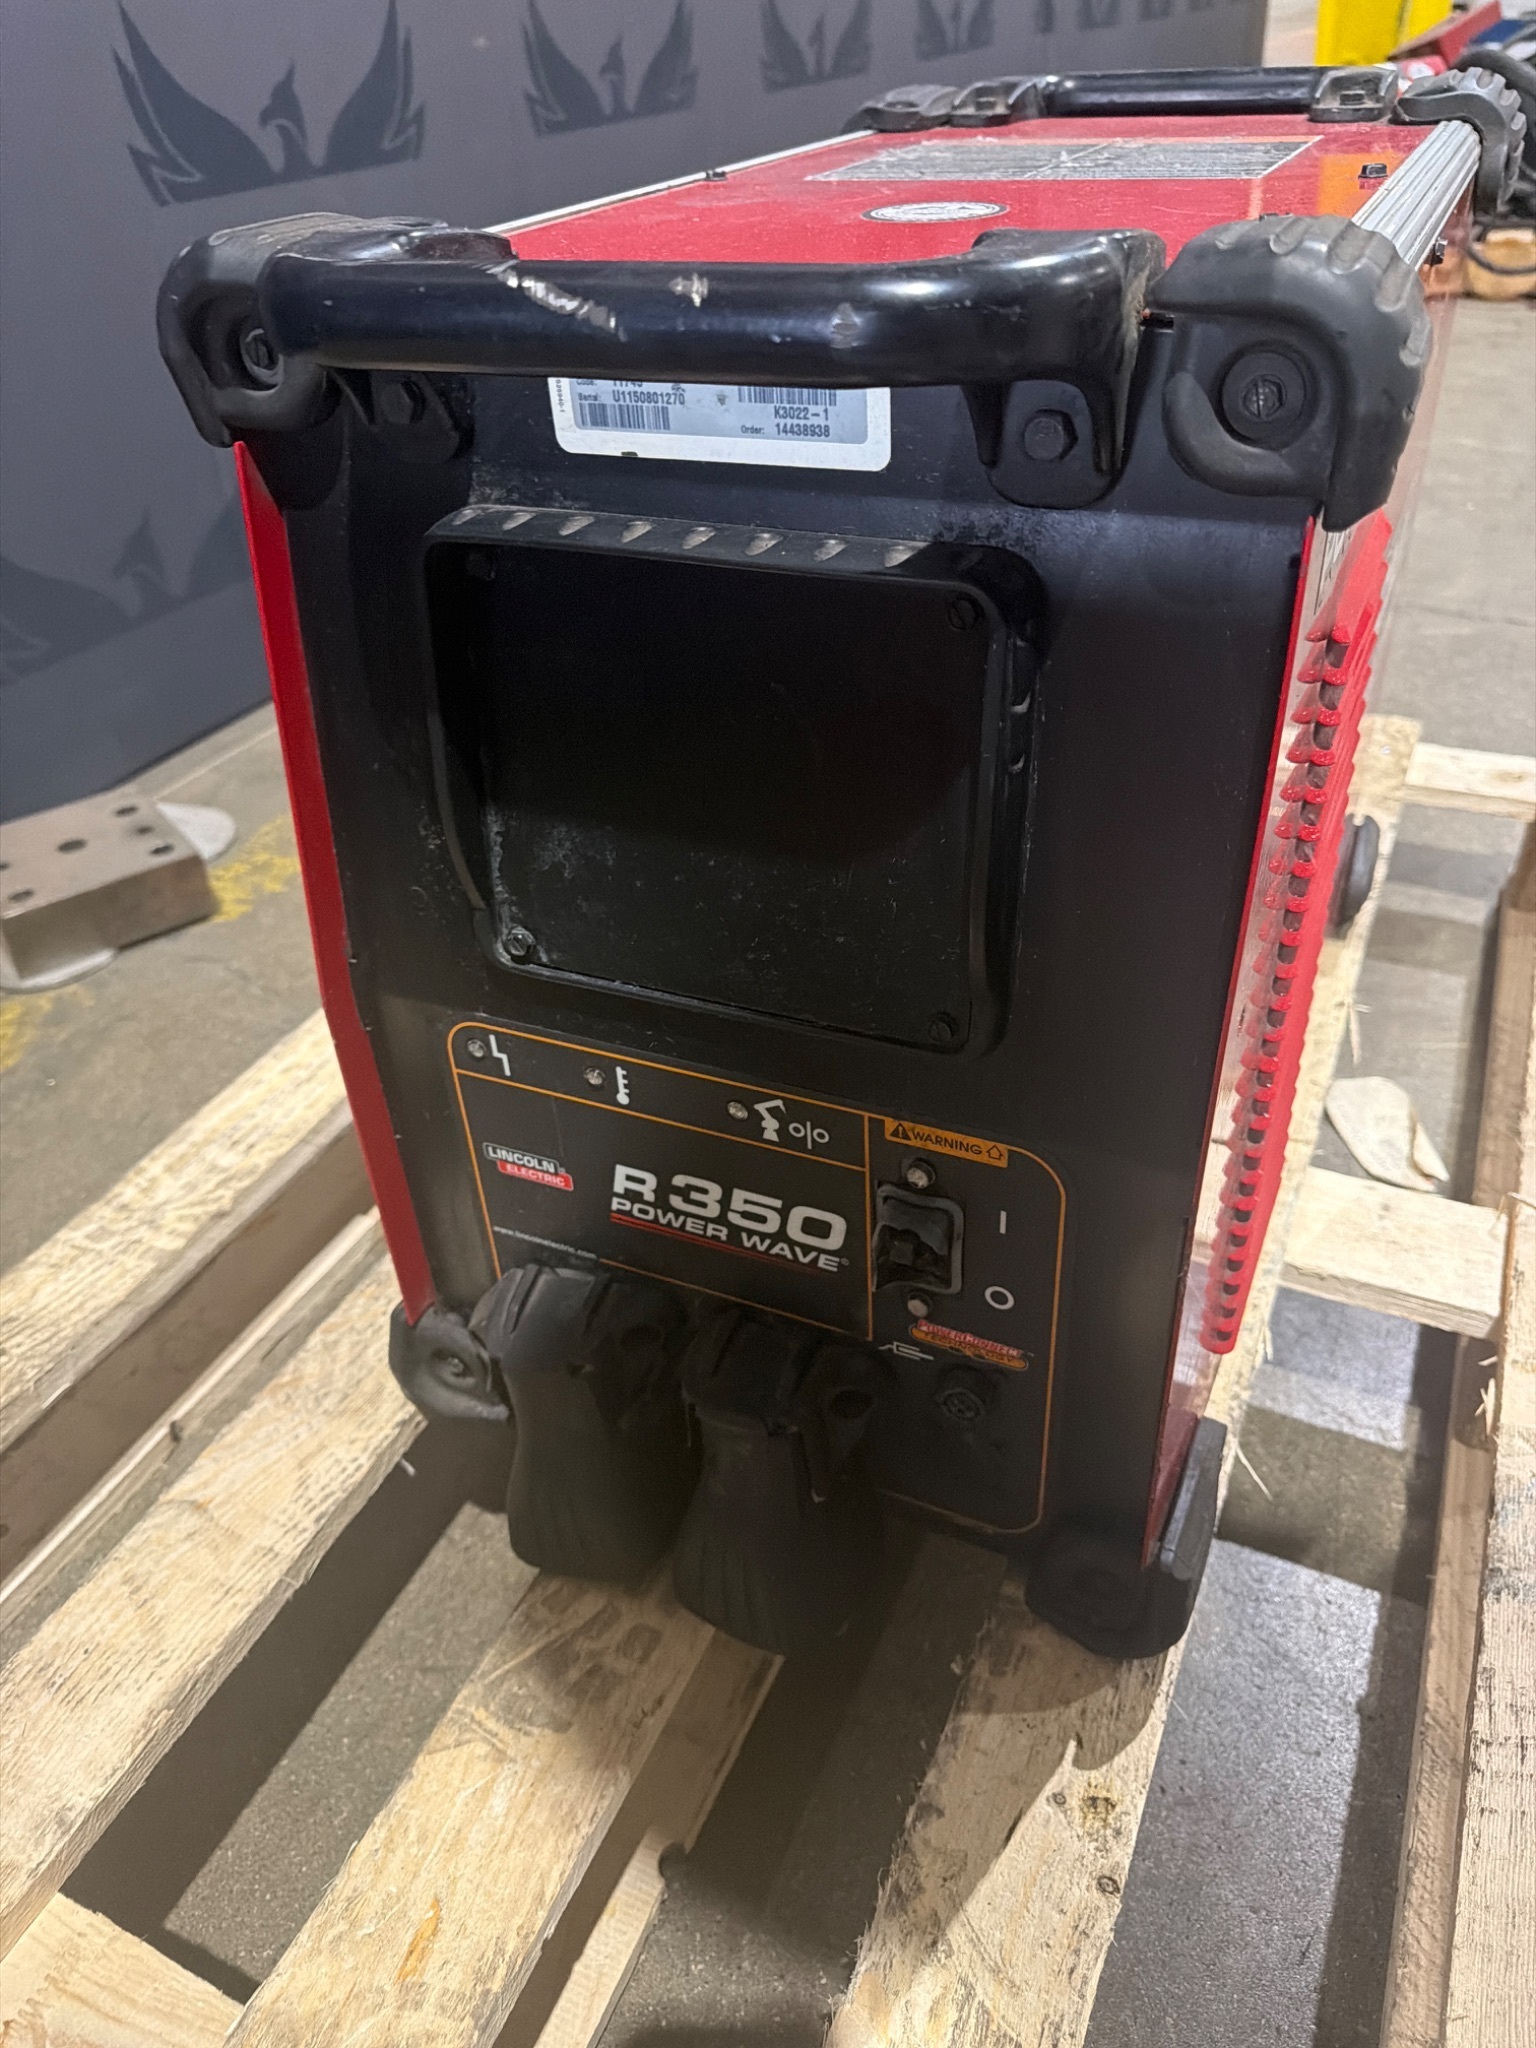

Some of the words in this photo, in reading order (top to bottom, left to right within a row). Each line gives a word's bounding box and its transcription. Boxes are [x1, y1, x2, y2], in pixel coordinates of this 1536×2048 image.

[612, 389, 685, 405] U1150801270
[741, 424, 765, 435] Order:
[775, 422, 830, 437] 14438938
[911, 1129, 982, 1155] WARNING
[487, 1146, 556, 1173] LINCOLN
[506, 1164, 566, 1187] ELECTRIC
[611, 1197, 728, 1241] POWER
[613, 1164, 657, 1202] R
[669, 1174, 847, 1250] 350
